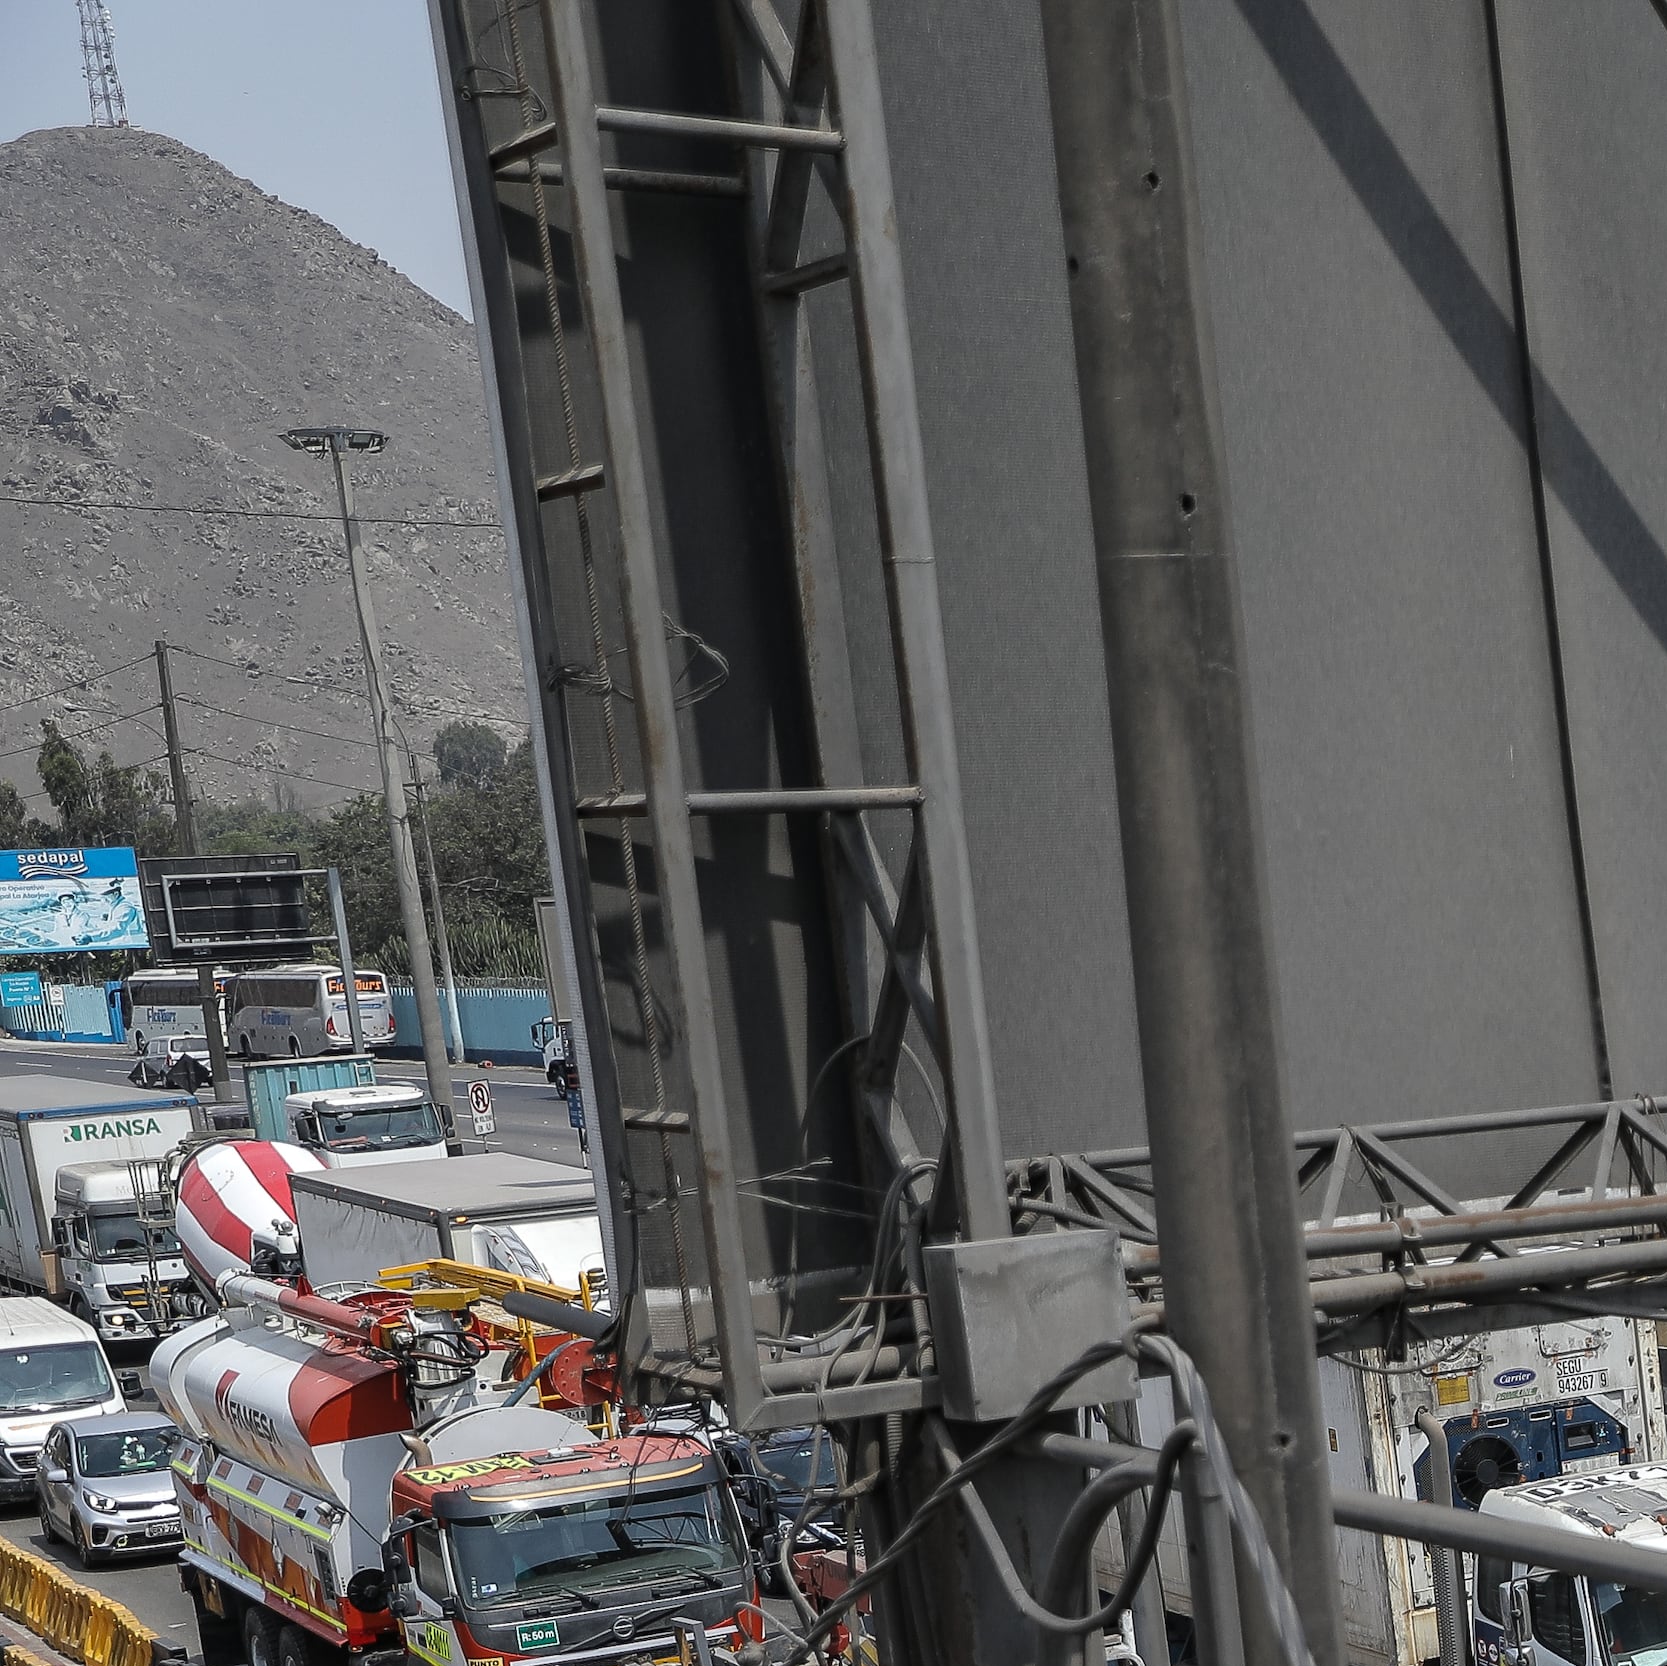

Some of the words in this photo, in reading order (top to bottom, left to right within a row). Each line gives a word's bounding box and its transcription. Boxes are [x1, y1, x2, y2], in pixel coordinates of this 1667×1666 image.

[18, 850, 83, 865] sedapal
[328, 978, 381, 992] FicTours
[84, 1117, 161, 1141] RANSA
[1556, 1359, 1582, 1376] SEGU
[1499, 1372, 1532, 1384] Carrier
[1558, 1374, 1594, 1394] 943267
[1600, 1372, 1607, 1387] 9
